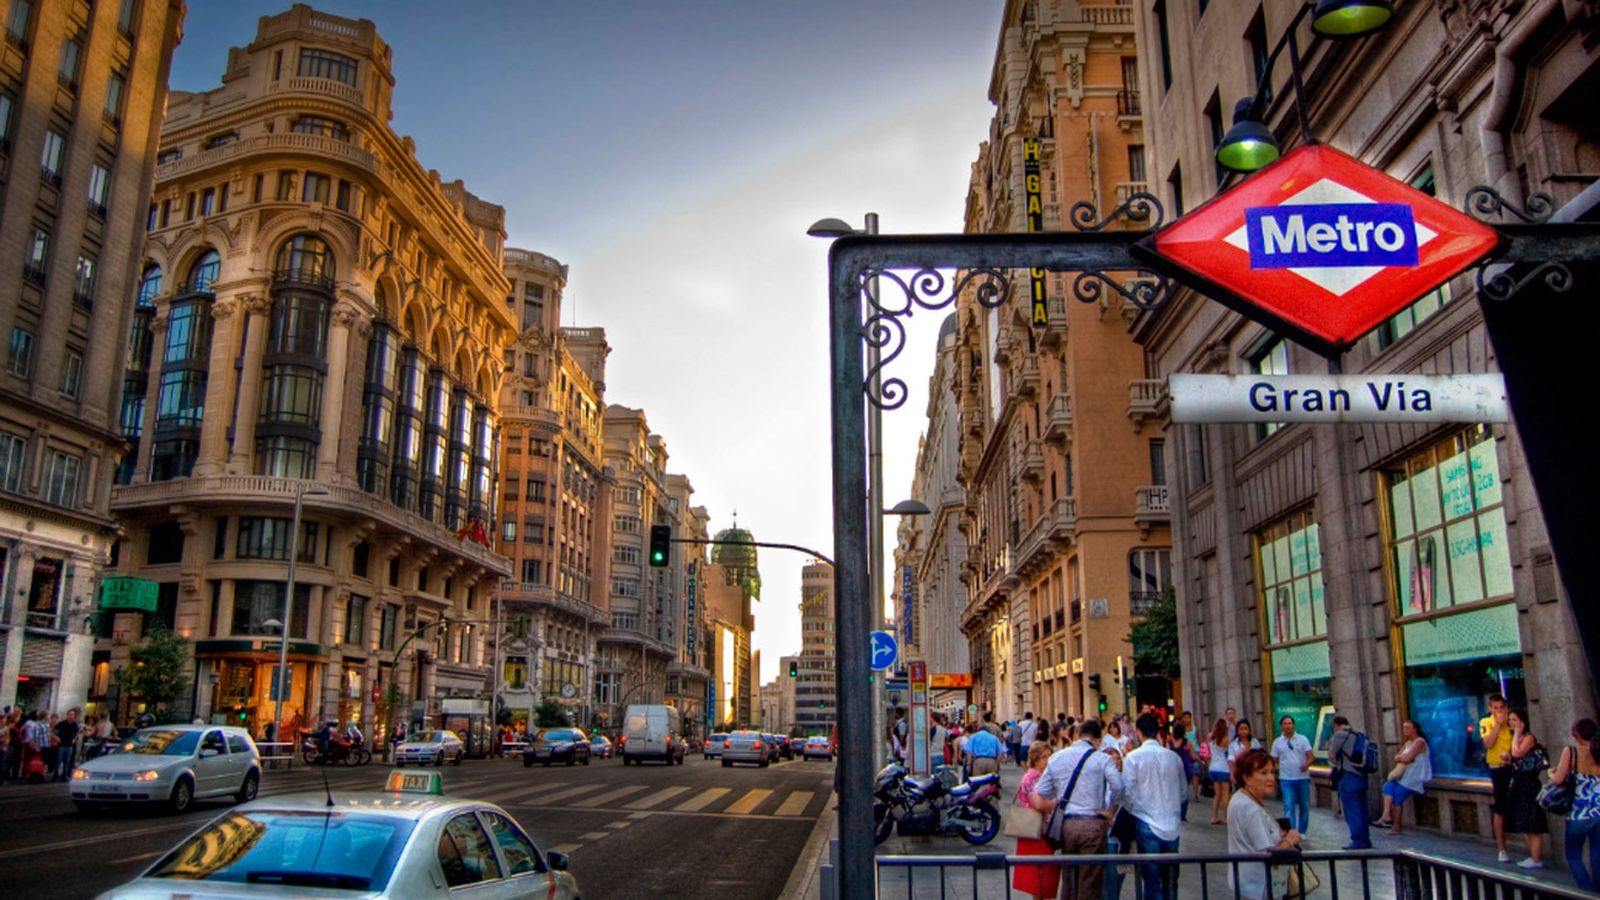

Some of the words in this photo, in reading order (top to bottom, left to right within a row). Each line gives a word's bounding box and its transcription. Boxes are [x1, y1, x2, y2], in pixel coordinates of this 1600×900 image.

[1260, 214, 1406, 255] Metro
[1249, 382, 1351, 412] Gran
[403, 774, 430, 788] TAXI
